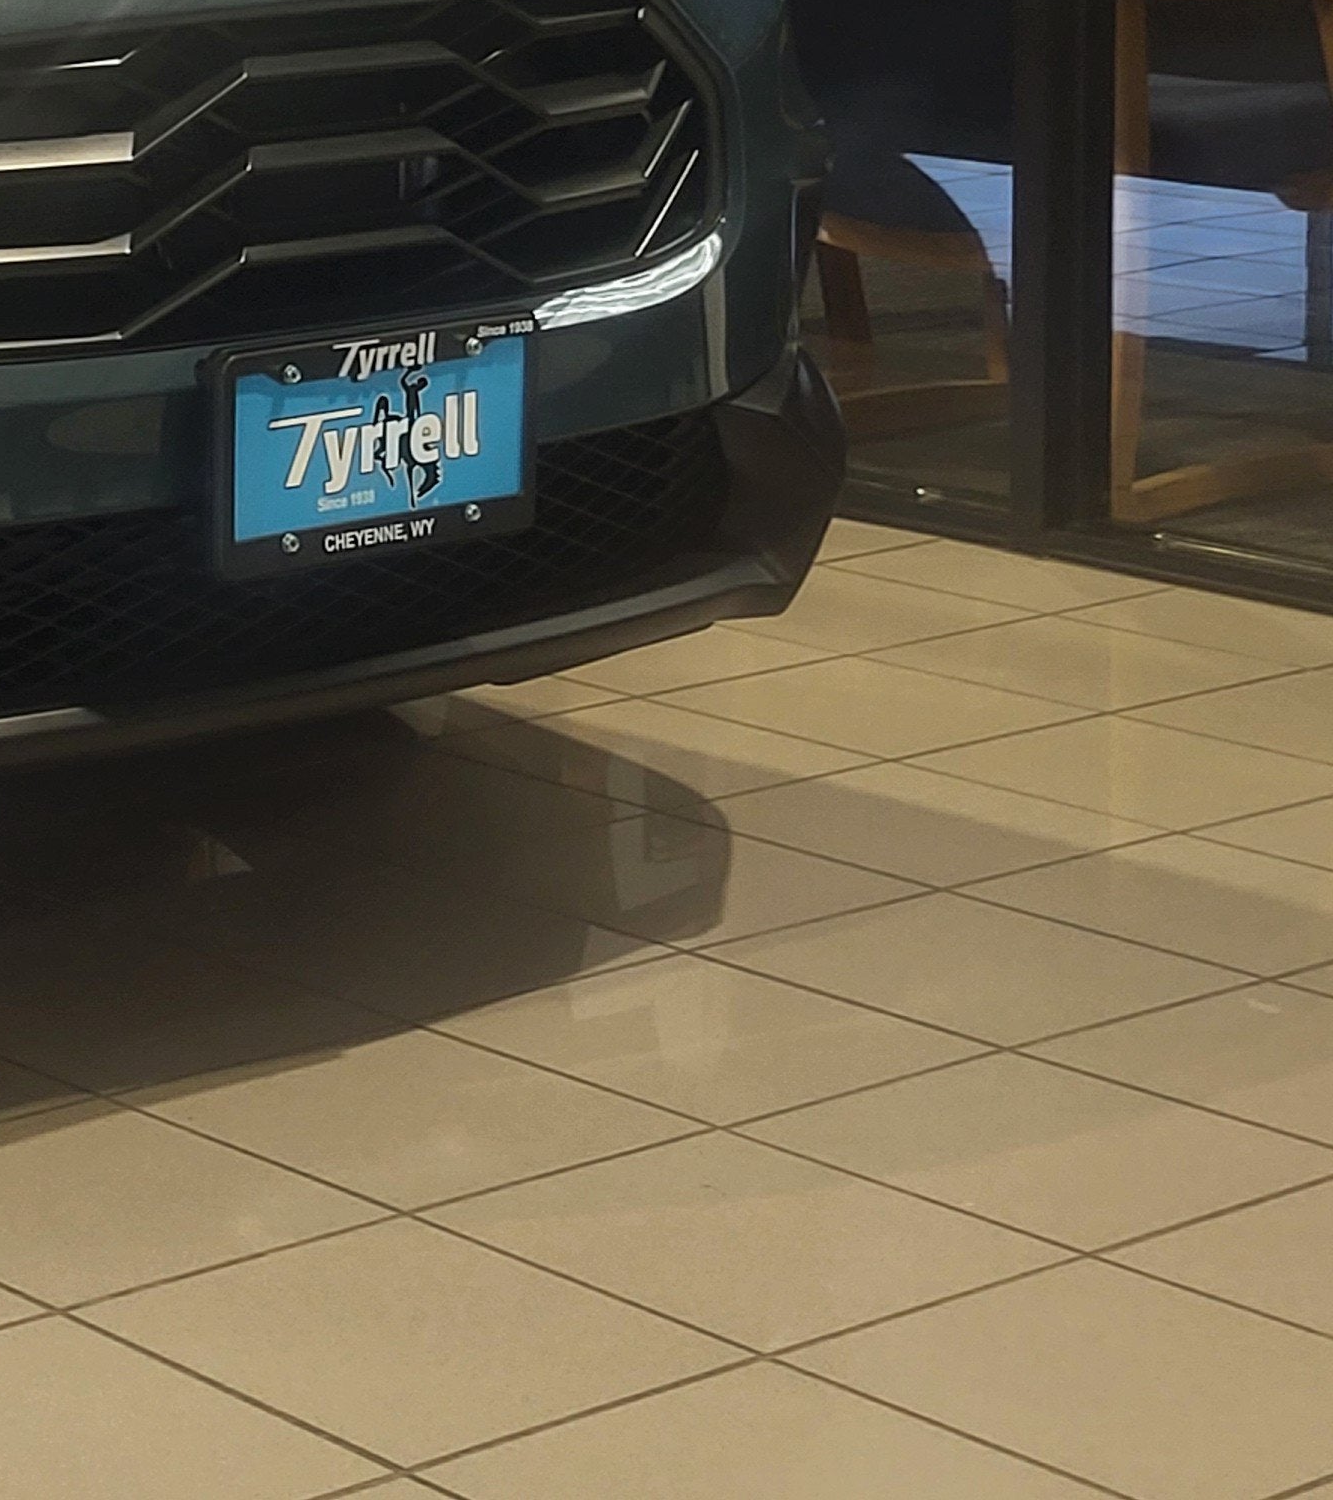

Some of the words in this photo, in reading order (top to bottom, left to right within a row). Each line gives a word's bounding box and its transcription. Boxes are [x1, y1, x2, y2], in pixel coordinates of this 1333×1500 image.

[477, 325, 507, 338] Since
[333, 332, 436, 380] Tyrrell
[268, 391, 479, 494] Tyrrell
[324, 523, 409, 552] CHEYENNE,
[410, 518, 435, 537] WY
